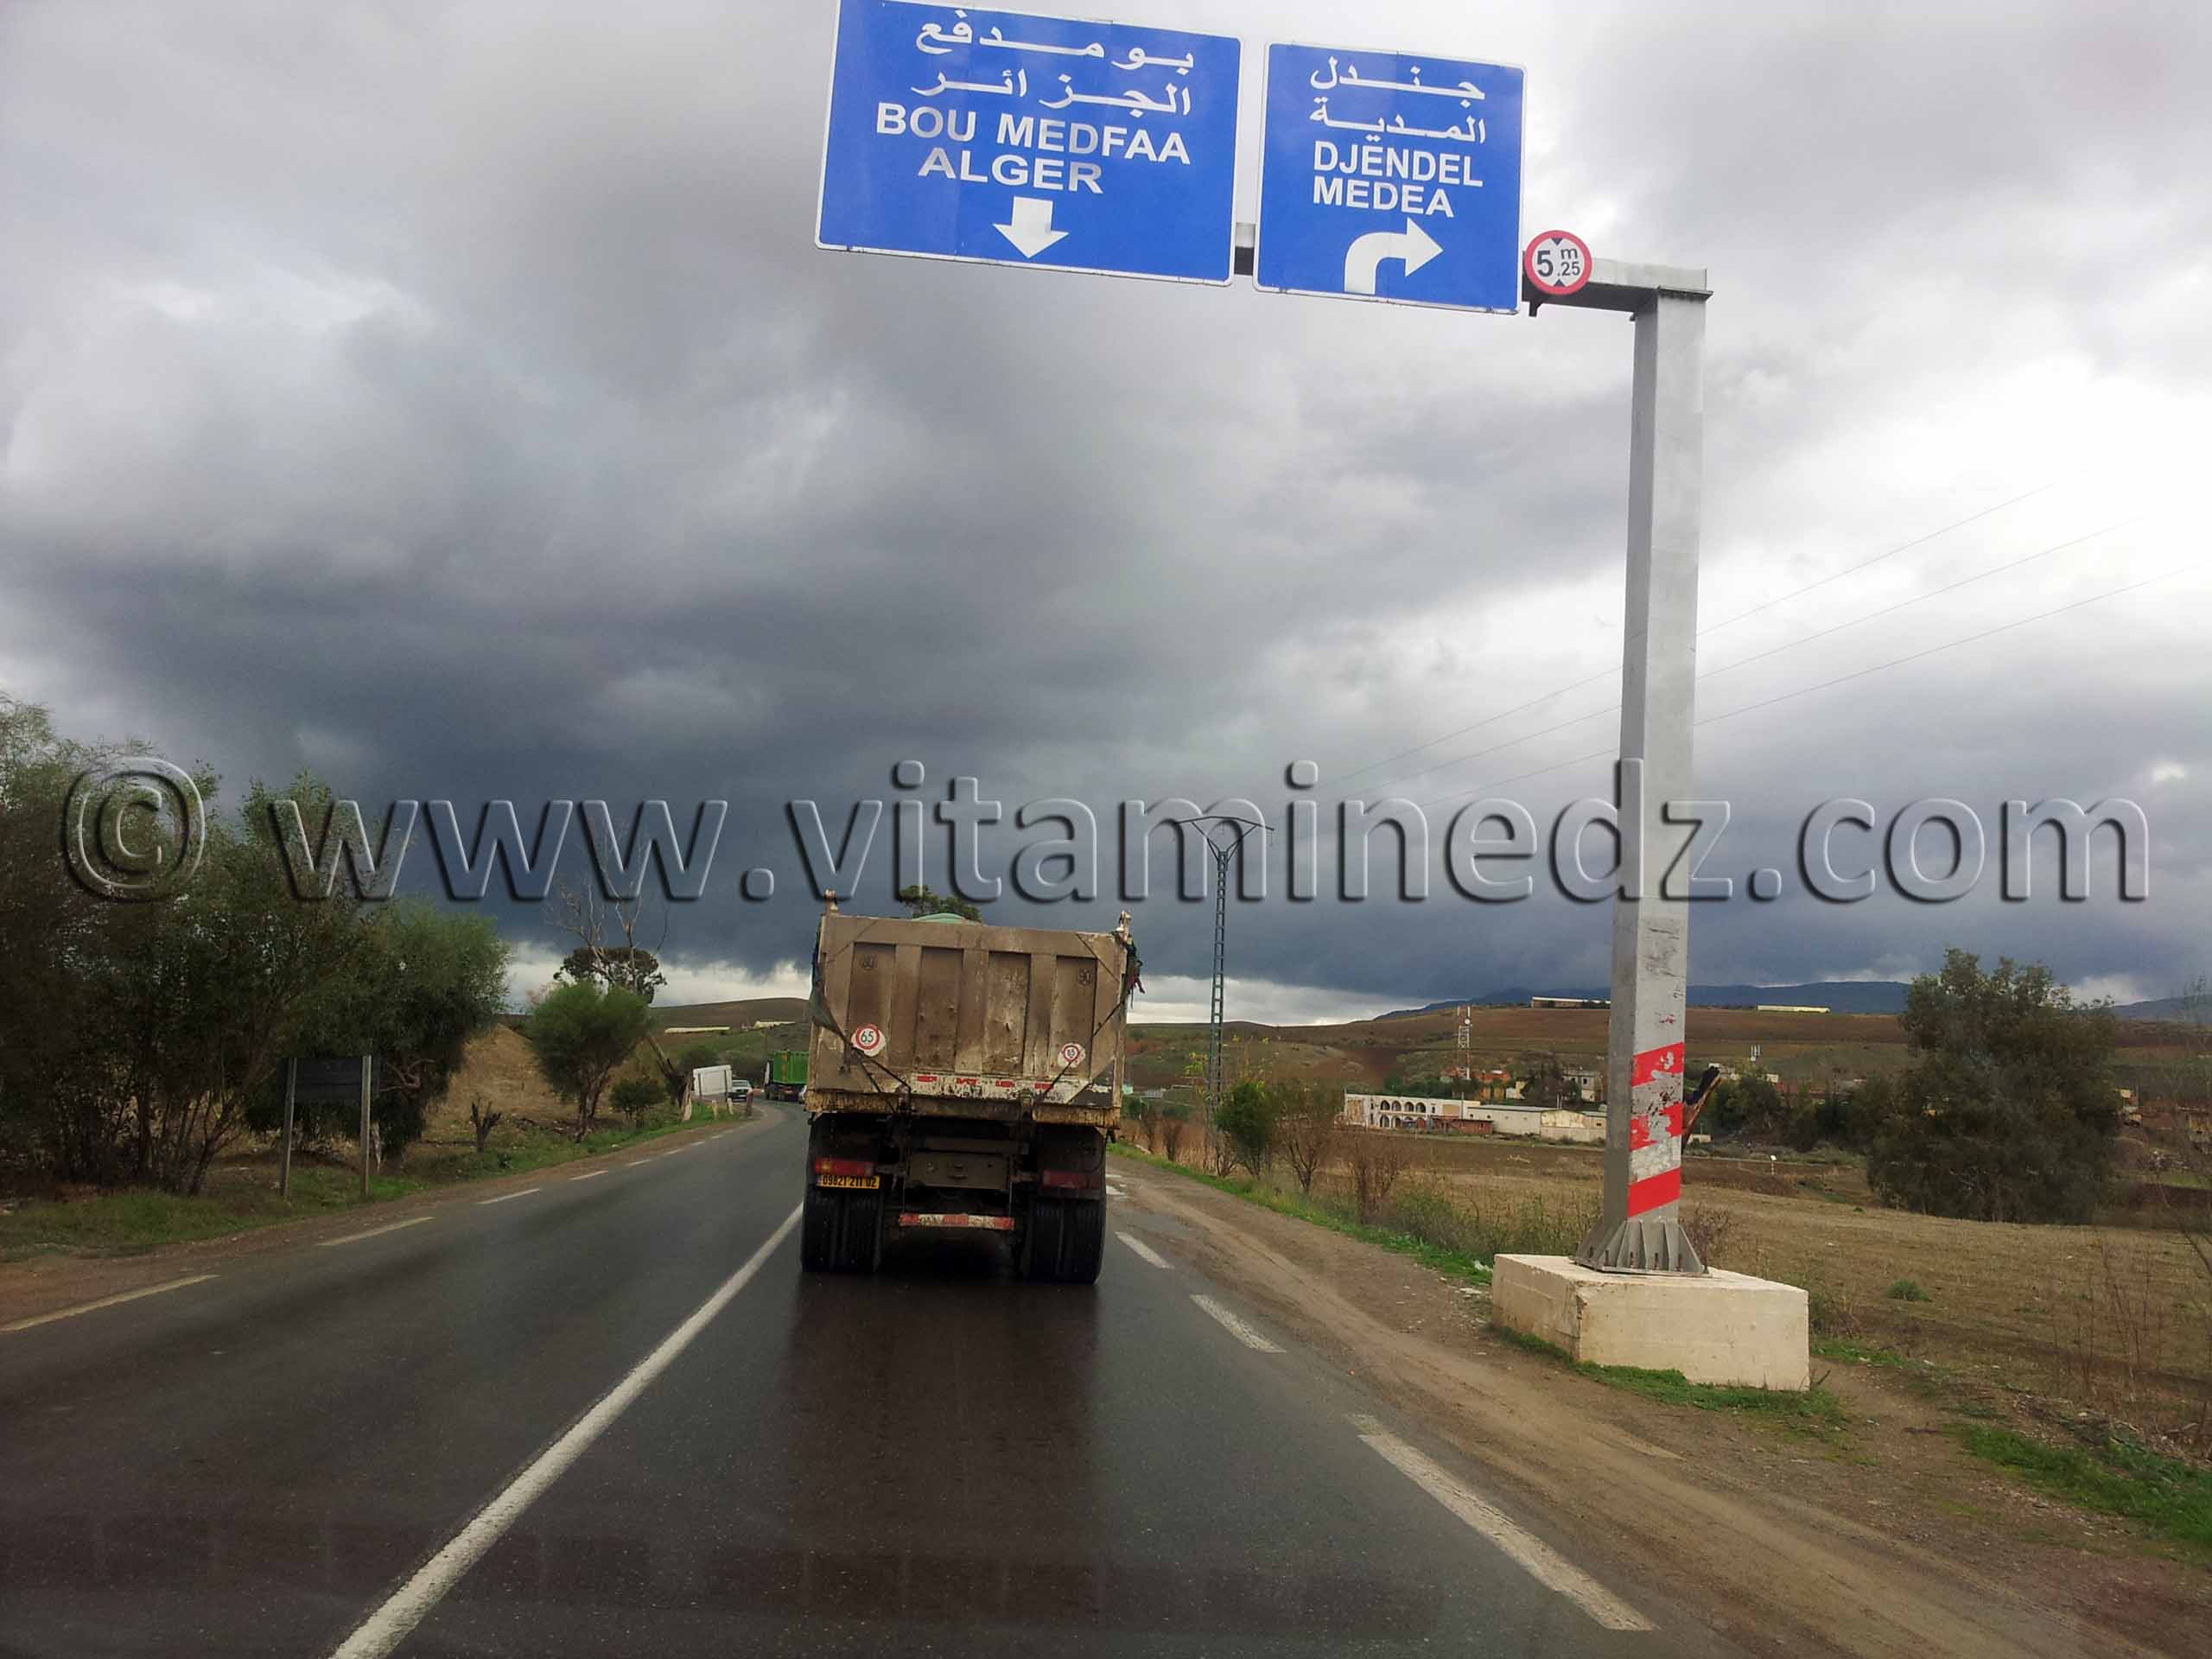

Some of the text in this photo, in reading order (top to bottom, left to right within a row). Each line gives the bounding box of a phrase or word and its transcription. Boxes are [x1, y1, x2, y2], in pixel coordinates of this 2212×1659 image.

[916, 10, 1193, 76] بو مدفع
[1310, 56, 1485, 109] جندل
[876, 102, 1191, 164] BOU MEDFAA
[1309, 97, 1486, 143] المدية
[918, 147, 1103, 194] ALGER
[1314, 140, 1484, 188] DJENDEL
[1313, 176, 1455, 218] MEDEA
[861, 1030, 874, 1043] 65
